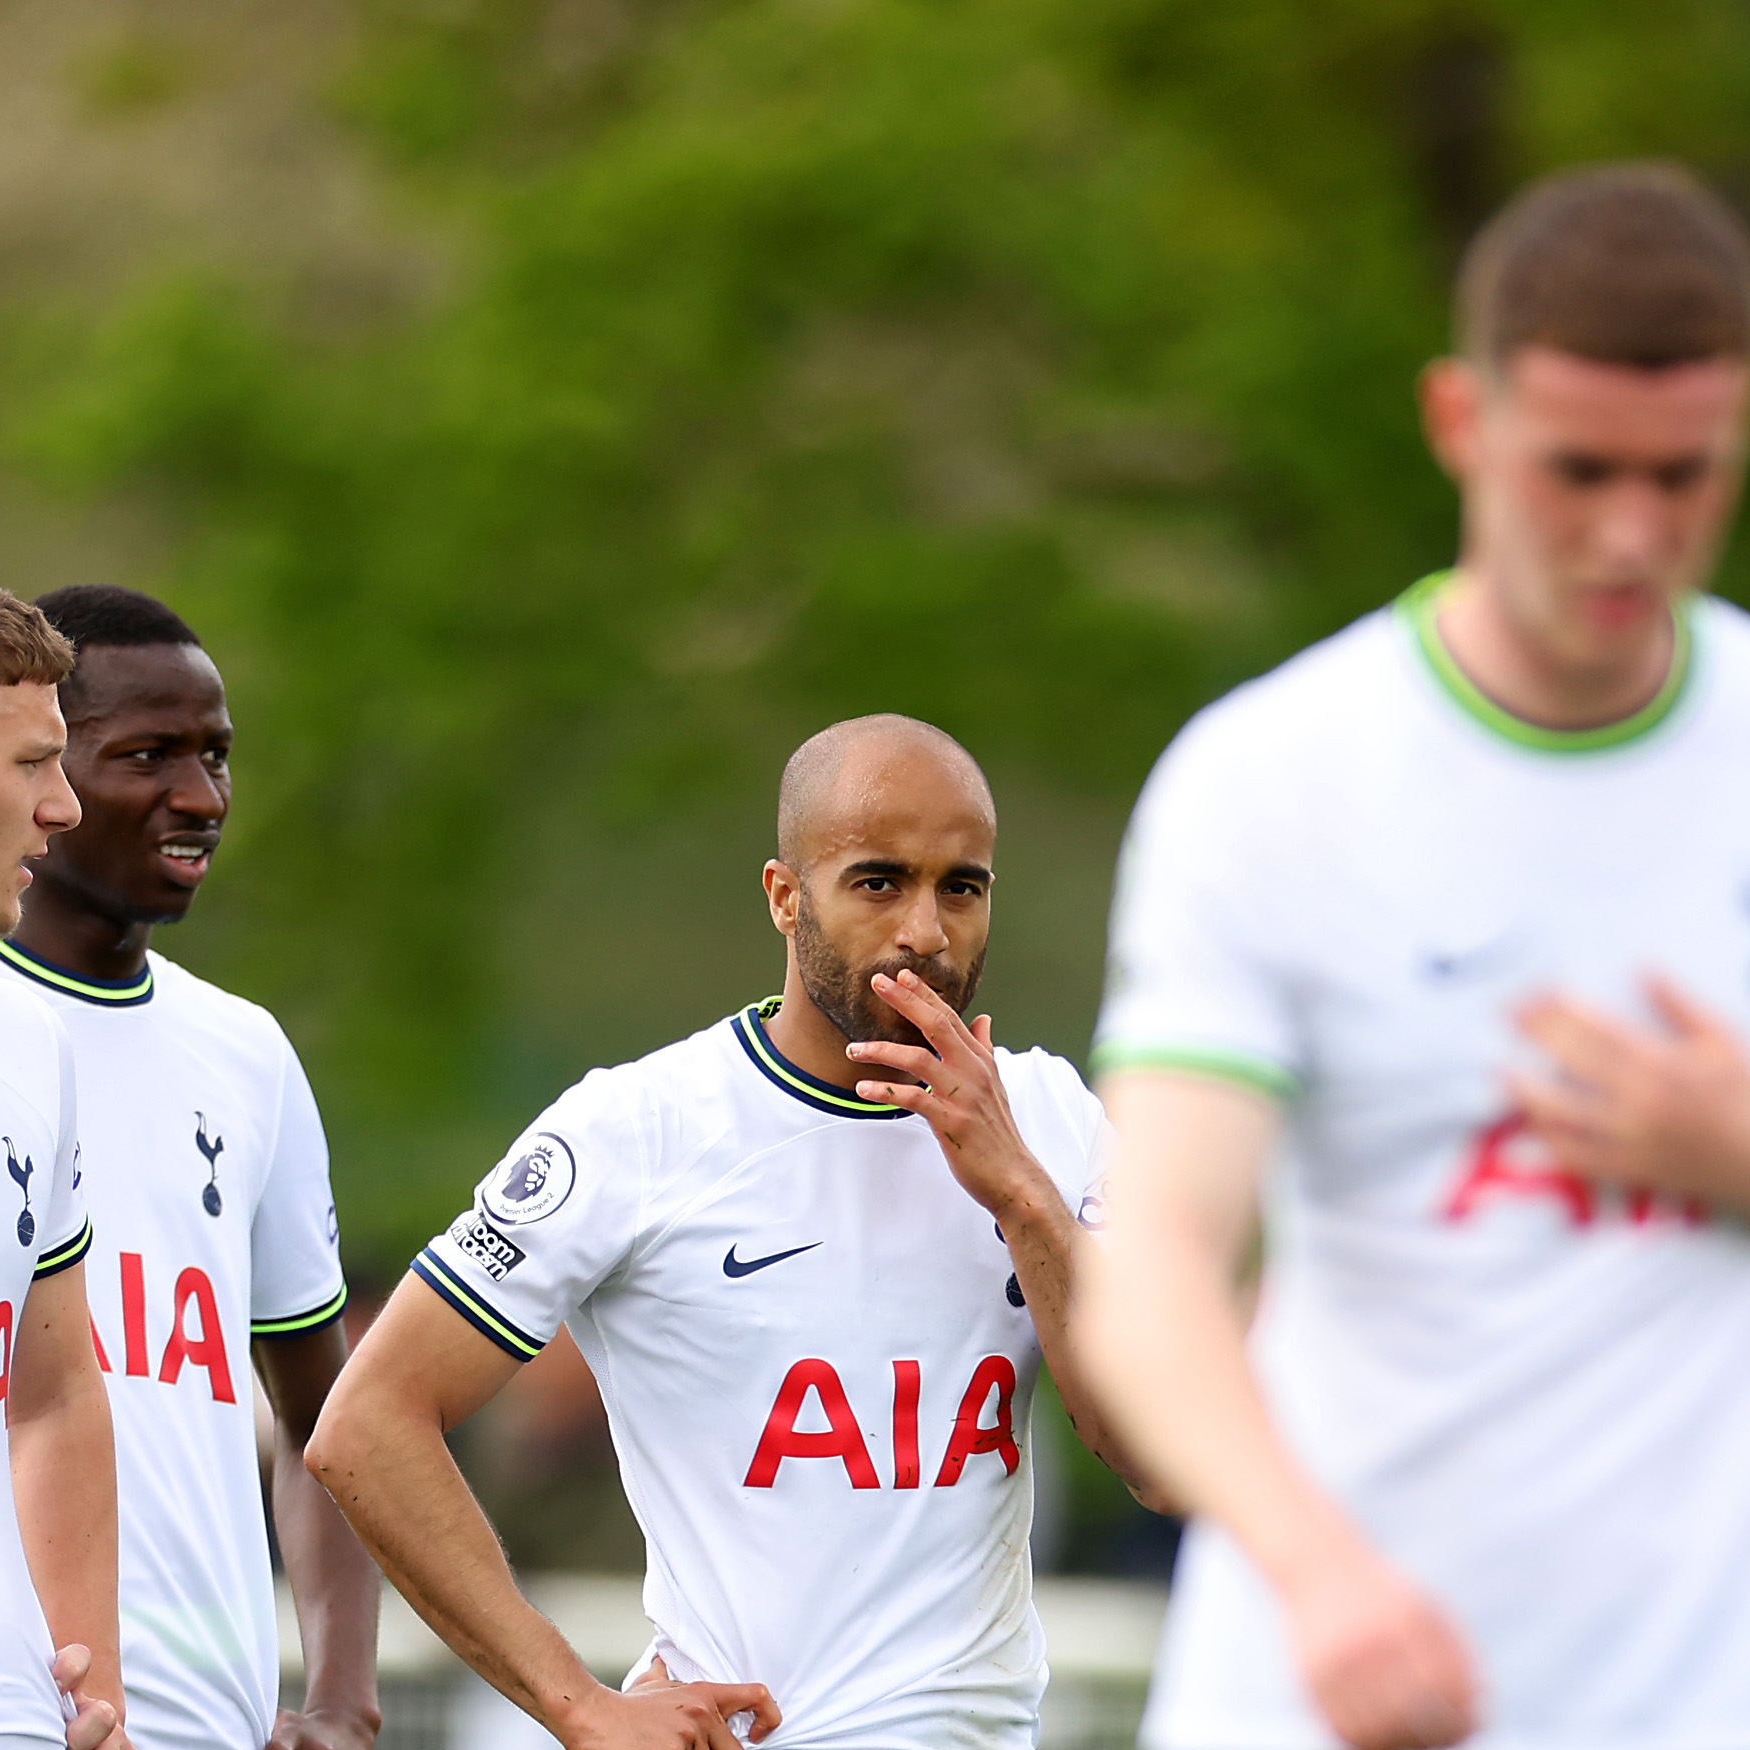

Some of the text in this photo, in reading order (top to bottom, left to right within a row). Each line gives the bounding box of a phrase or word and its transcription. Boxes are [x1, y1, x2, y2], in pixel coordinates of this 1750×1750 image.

[523, 1198, 550, 1214] League
[89, 1251, 237, 1405] IA
[743, 1355, 1020, 1489] AIA
